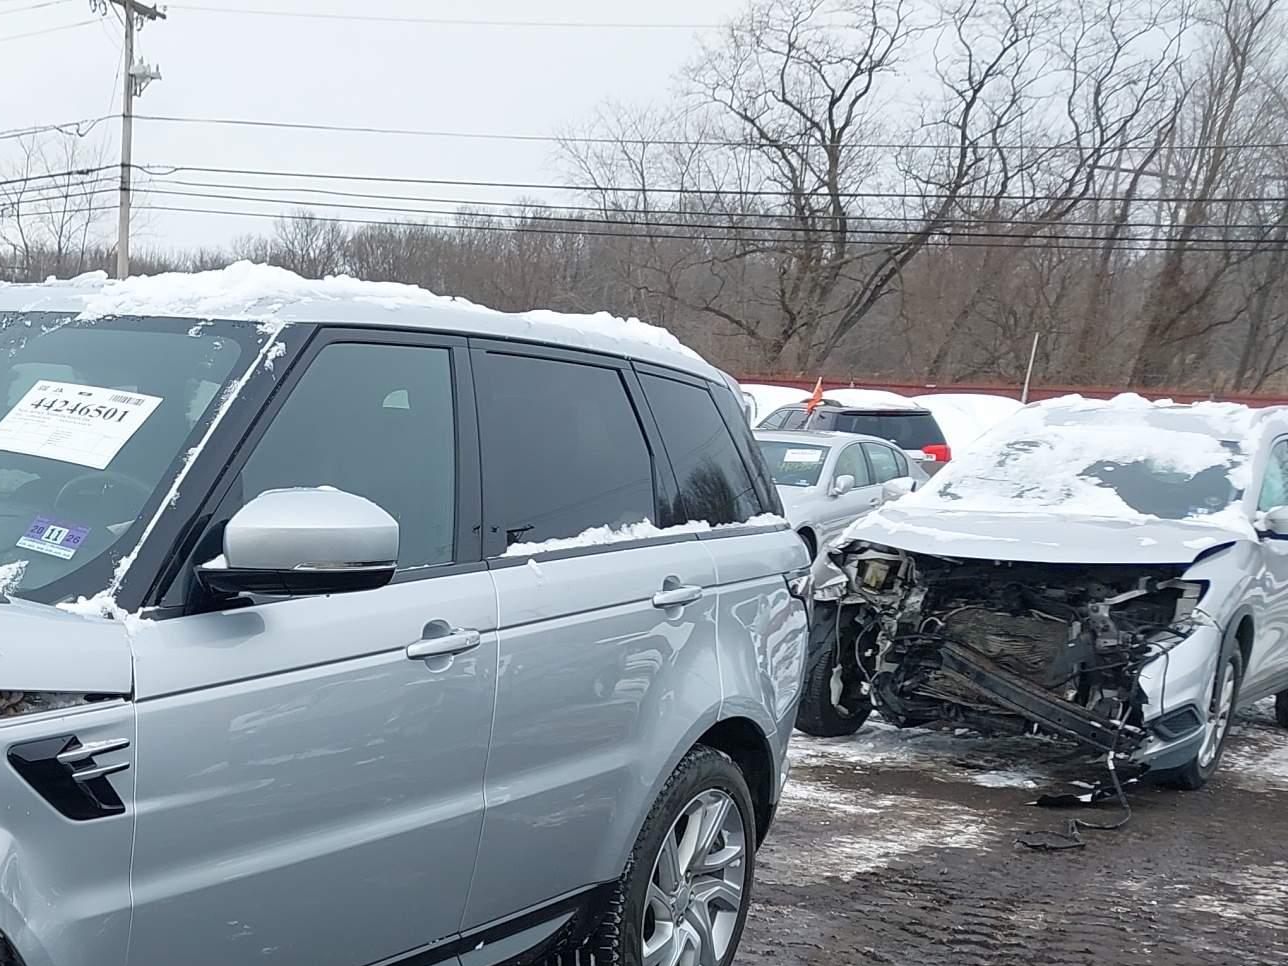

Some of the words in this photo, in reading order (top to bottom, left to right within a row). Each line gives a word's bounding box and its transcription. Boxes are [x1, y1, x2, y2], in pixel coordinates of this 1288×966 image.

[30, 397, 130, 423] 44246501
[30, 525, 45, 535] 20
[44, 527, 63, 542] 11
[66, 534, 81, 544] 26
